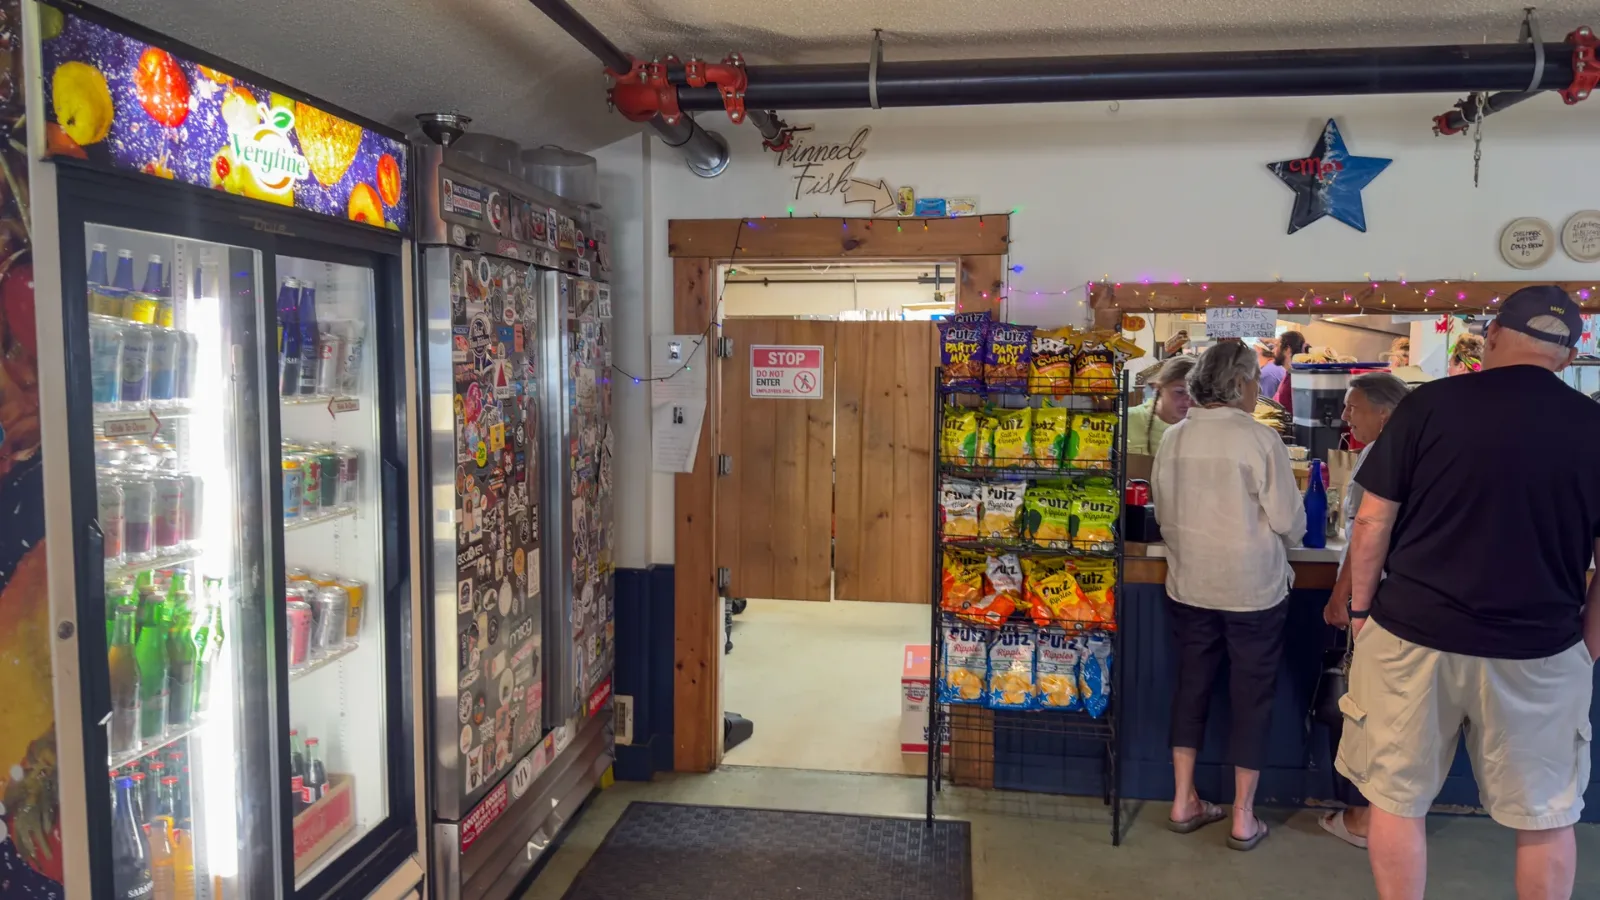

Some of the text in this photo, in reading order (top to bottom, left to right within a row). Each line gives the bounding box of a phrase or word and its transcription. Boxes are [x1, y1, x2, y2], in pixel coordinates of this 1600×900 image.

[777, 127, 870, 166] Tinned
[231, 132, 306, 176] Veryfine
[793, 162, 852, 200] Fish
[945, 342, 978, 353] PARTY
[992, 343, 1027, 355] PARTY
[768, 351, 806, 366] STOP
[950, 353, 971, 363] MIX
[997, 354, 1019, 366] MIX
[1037, 354, 1070, 366] CURLS
[769, 370, 785, 378] NOT
[756, 378, 781, 386] ENTER
[1084, 512, 1111, 521] Ripples
[1043, 649, 1073, 660] Ripples
